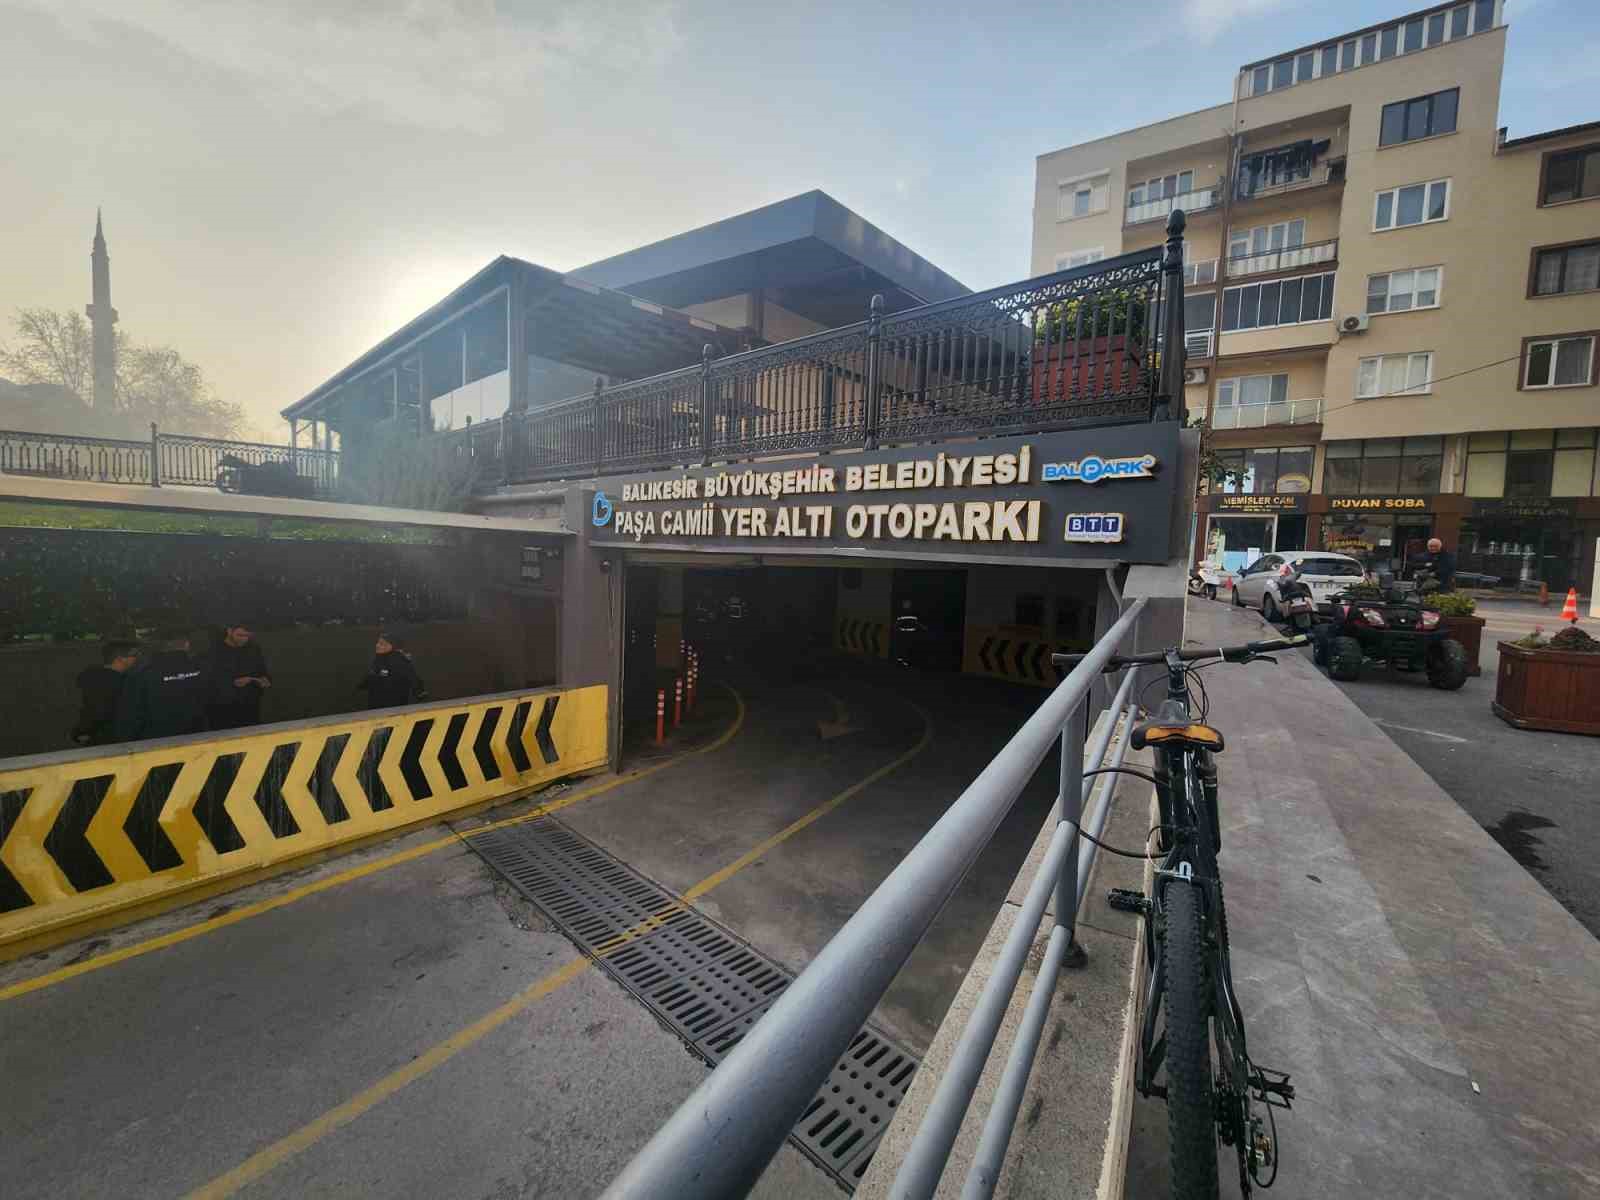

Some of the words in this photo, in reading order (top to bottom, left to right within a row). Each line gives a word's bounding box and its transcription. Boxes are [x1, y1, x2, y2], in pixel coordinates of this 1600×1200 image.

[622, 475, 698, 502] BALIKESİR
[704, 464, 836, 499] BÜYÜKŞEHİR
[845, 445, 1031, 491] BELEDİYESİ
[1044, 457, 1143, 482] BALPARK
[1331, 499, 1381, 509] DUVAN
[1385, 498, 1425, 508] SOBA
[614, 510, 655, 541] PAŞA
[660, 503, 713, 536] CAMİİ
[721, 507, 768, 536] YER
[774, 505, 832, 537] ALTI
[845, 500, 1041, 541] OTOPARKI
[1070, 518, 1117, 531] BTT
